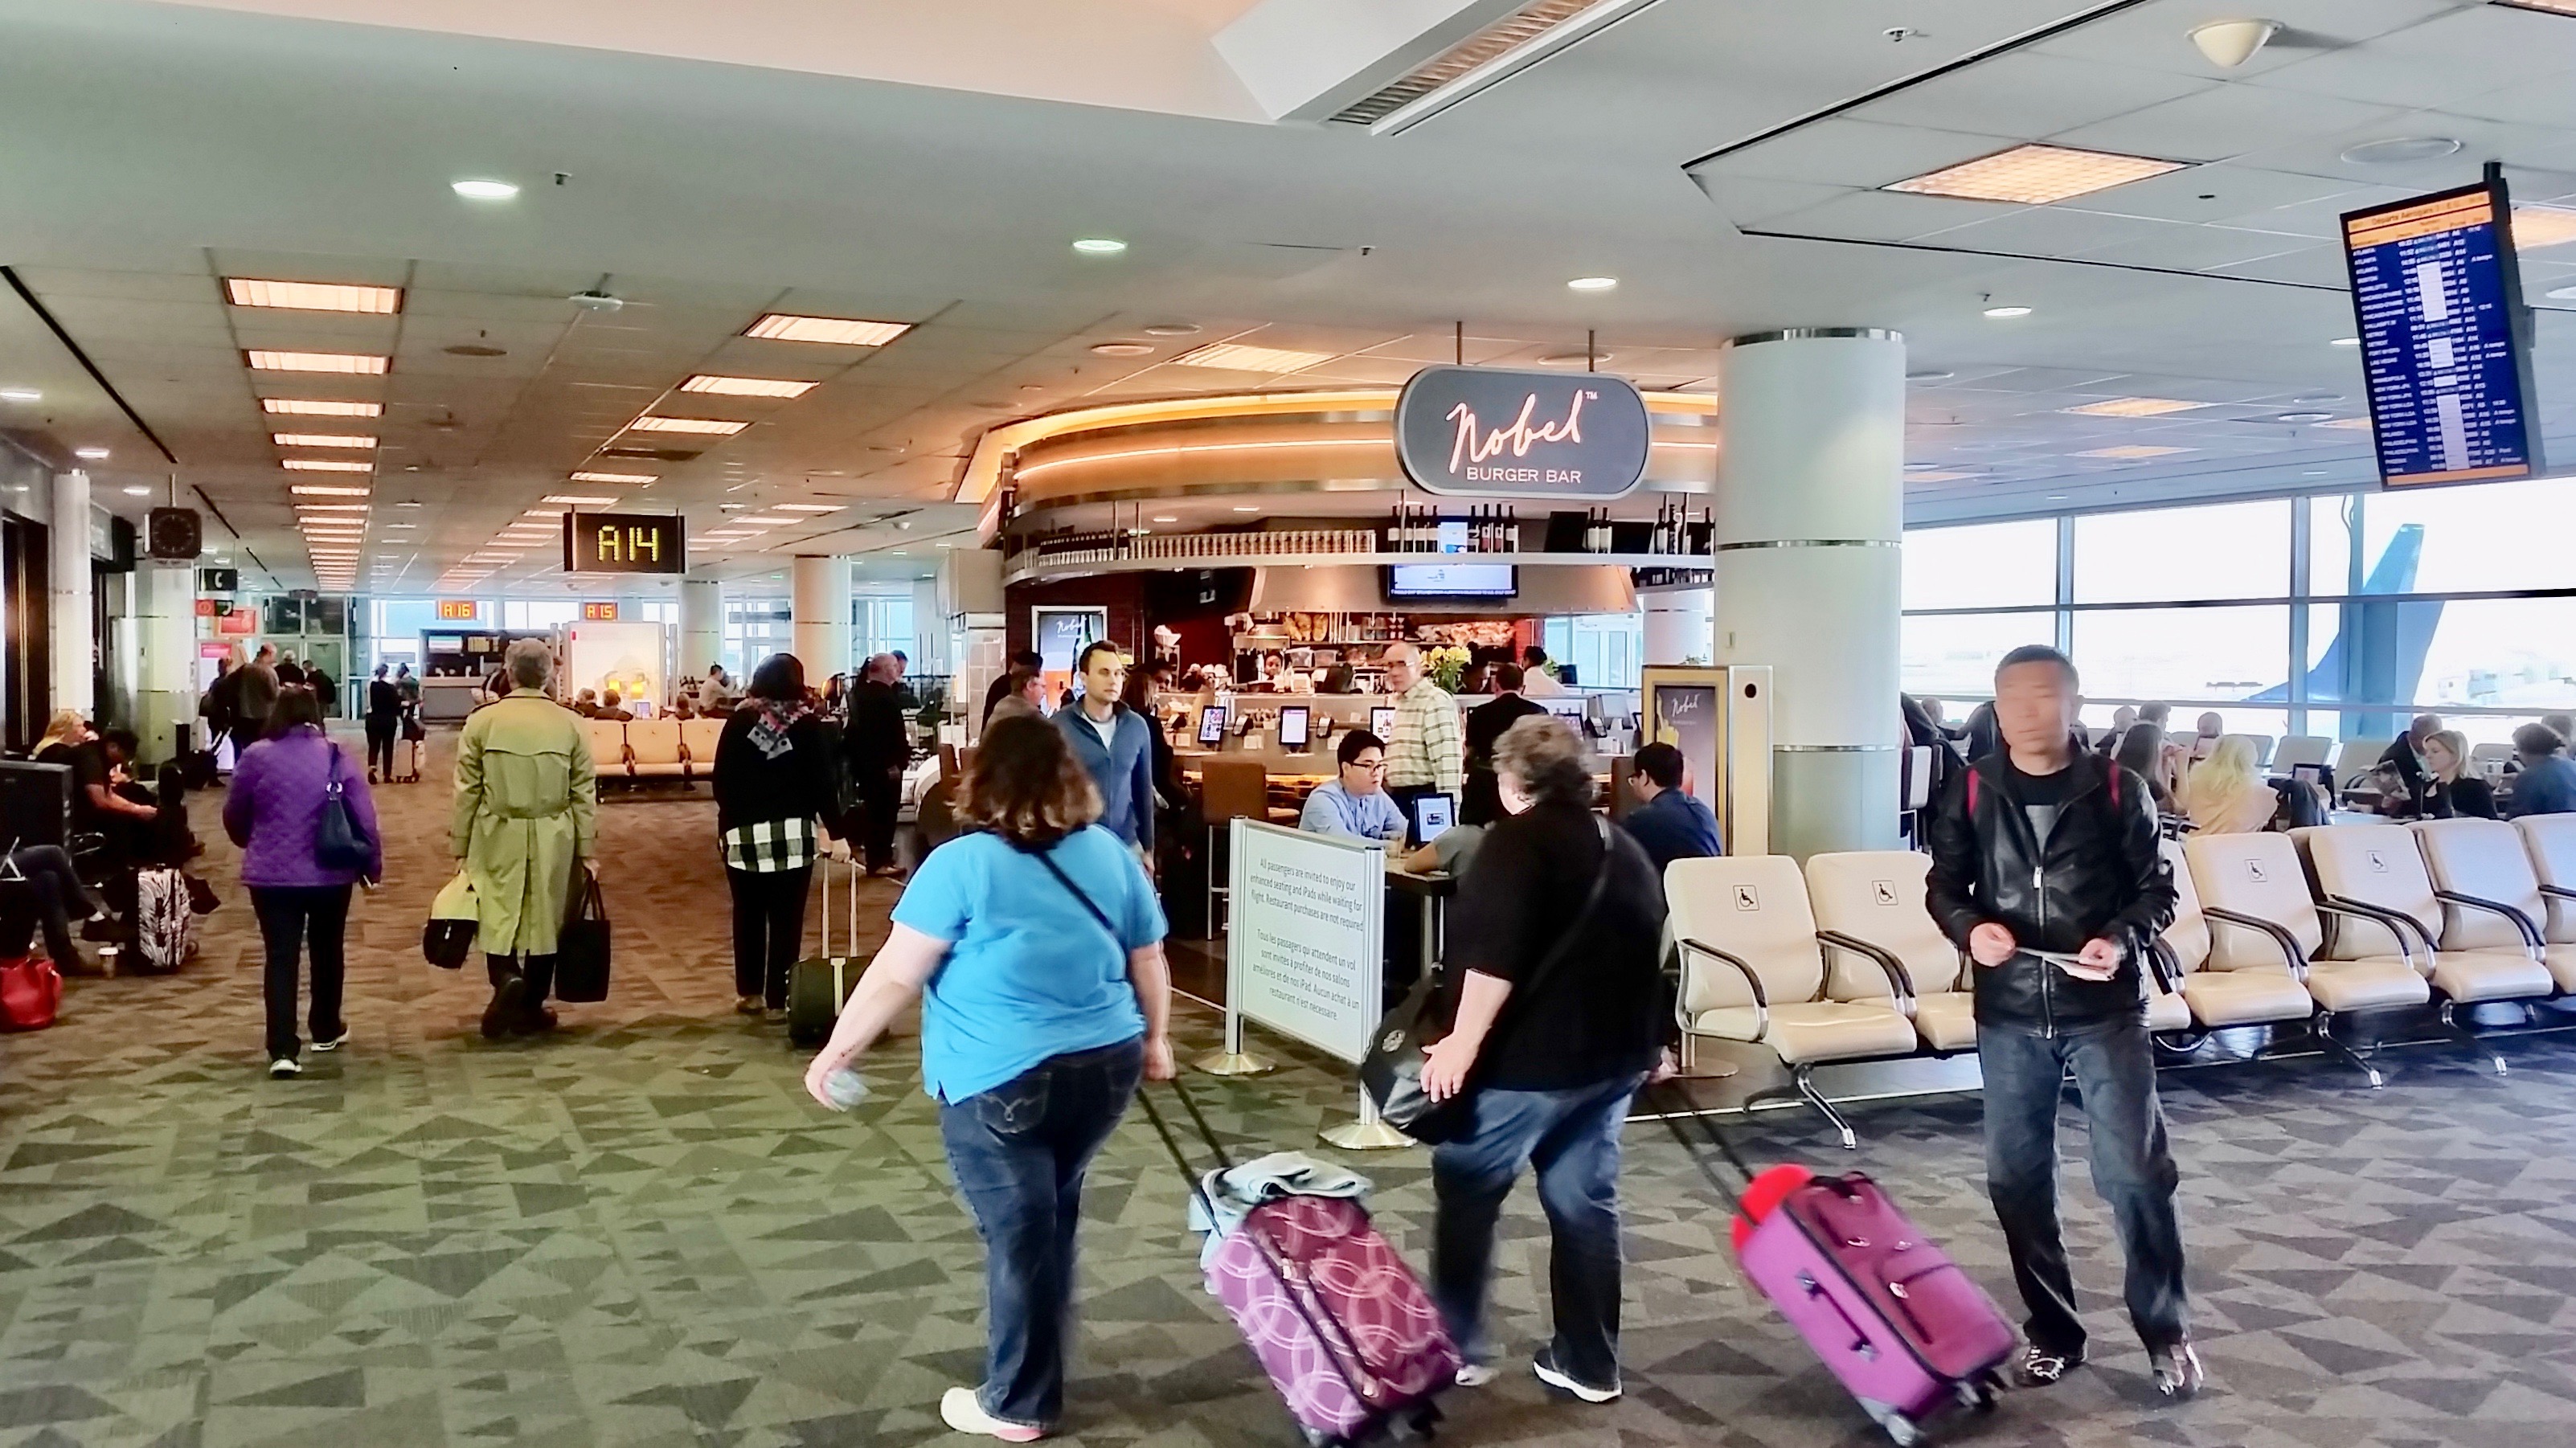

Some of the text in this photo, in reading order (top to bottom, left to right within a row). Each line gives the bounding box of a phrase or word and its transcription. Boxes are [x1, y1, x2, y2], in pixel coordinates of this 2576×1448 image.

[1446, 389, 1583, 474] Nobel
[1466, 466, 1582, 484] BURGER BAR
[1250, 874, 1362, 913] enhanced seating and iPads while waiting for
[1267, 861, 1294, 877] passengers
[1295, 868, 1304, 878] are
[1304, 868, 1322, 883] invited
[1329, 876, 1345, 892] enjoy
[1345, 881, 1356, 891] our
[1265, 893, 1292, 910] Restaurant
[1293, 903, 1319, 918] purchases
[1319, 910, 1329, 922] are
[1329, 914, 1339, 925] not
[1256, 927, 1356, 971] Tous les passagers qui attendent un vol
[1260, 949, 1272, 960] sont
[1293, 960, 1313, 974] profiter
[1321, 970, 1332, 981] nos
[1332, 973, 1349, 988] salons
[1269, 987, 1296, 1004] restaurant
[1282, 973, 1289, 984] de
[1289, 976, 1299, 988] nos
[1313, 983, 1330, 998] Aucun
[1330, 992, 1346, 1004] achat
[1351, 1000, 1359, 1009] un
